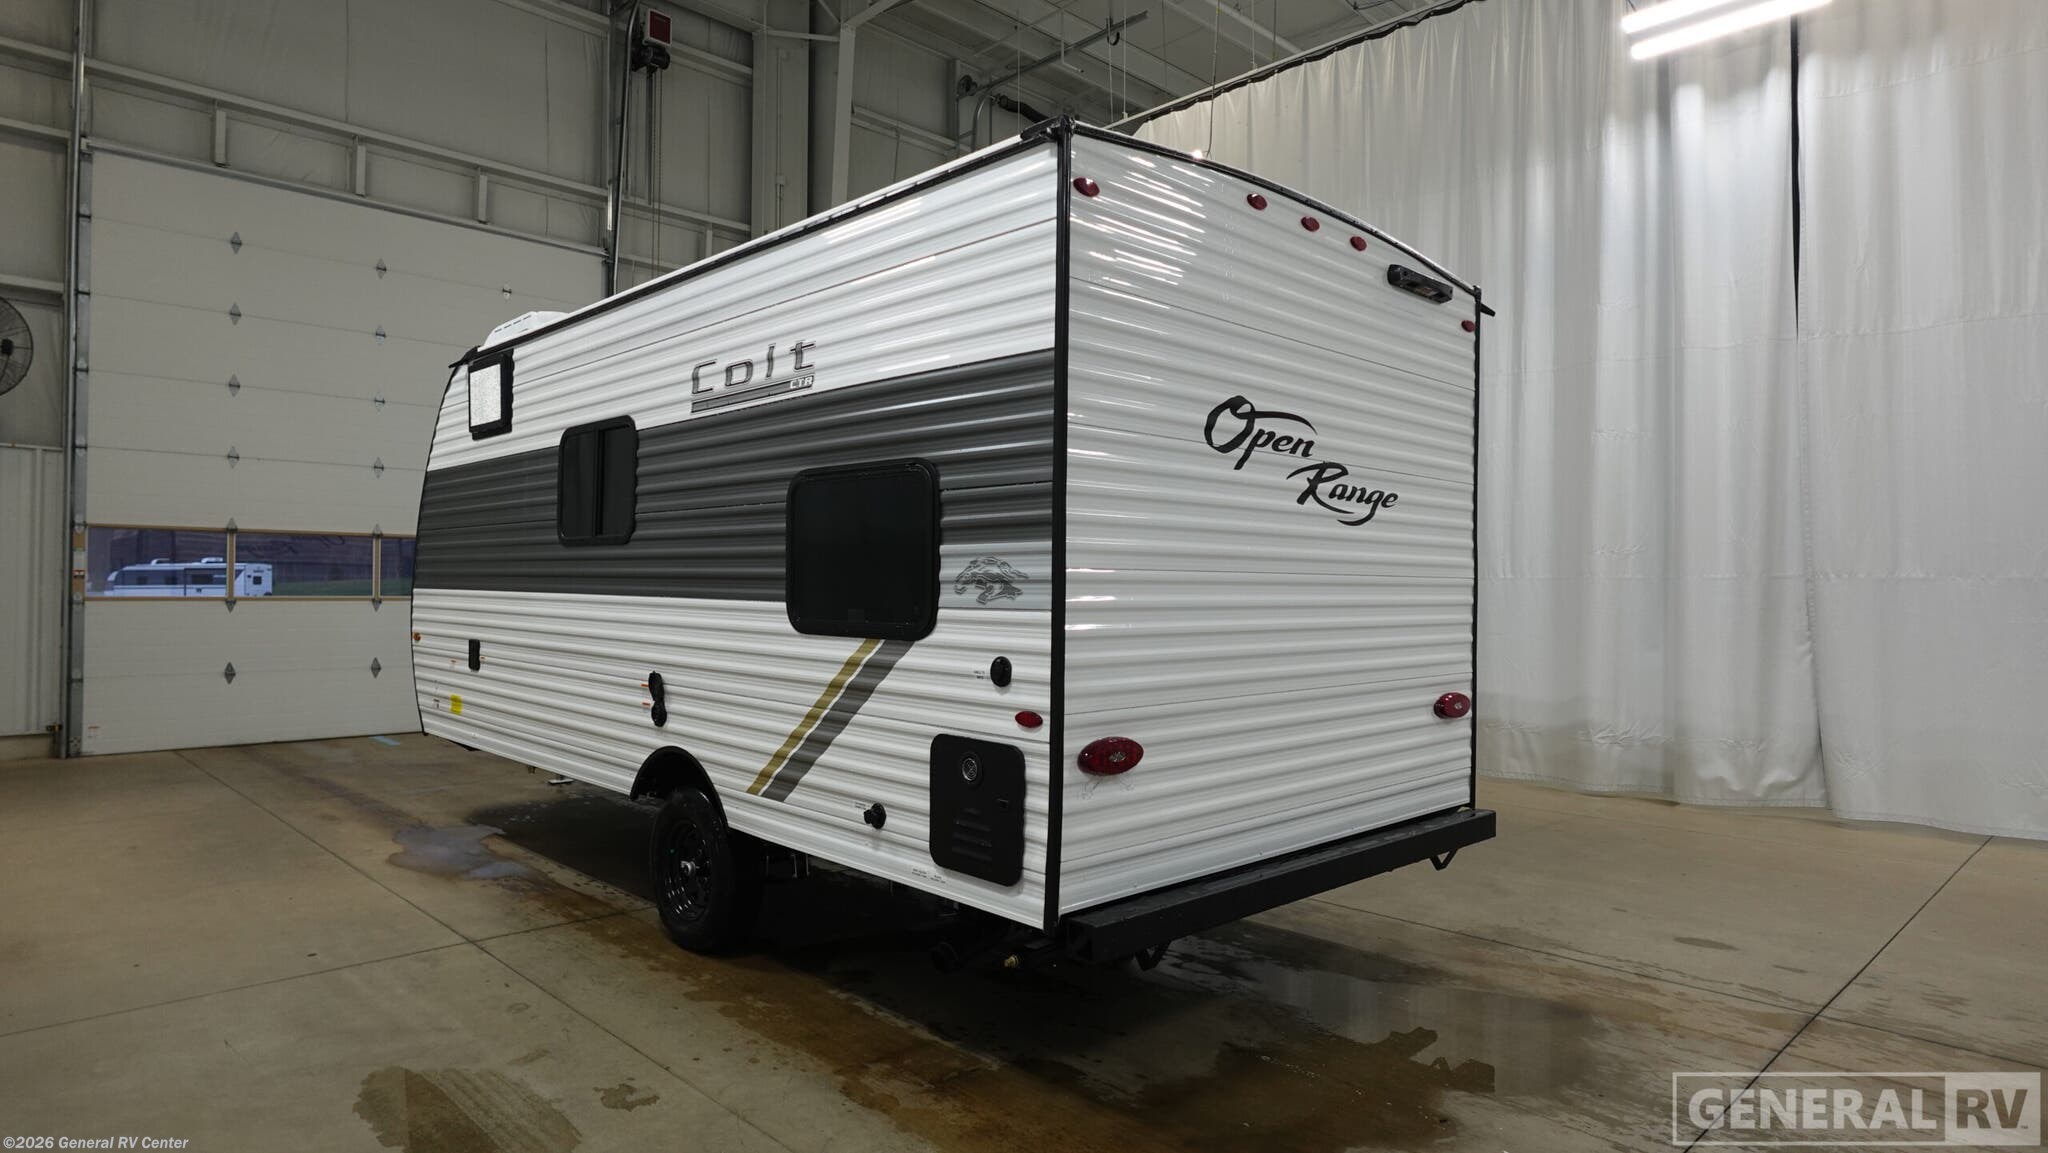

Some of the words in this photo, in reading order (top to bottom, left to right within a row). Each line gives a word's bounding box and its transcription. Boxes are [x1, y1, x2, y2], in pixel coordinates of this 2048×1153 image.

[691, 341, 816, 394] Colt
[1204, 395, 1318, 470] Open
[1286, 461, 1399, 526] Range
